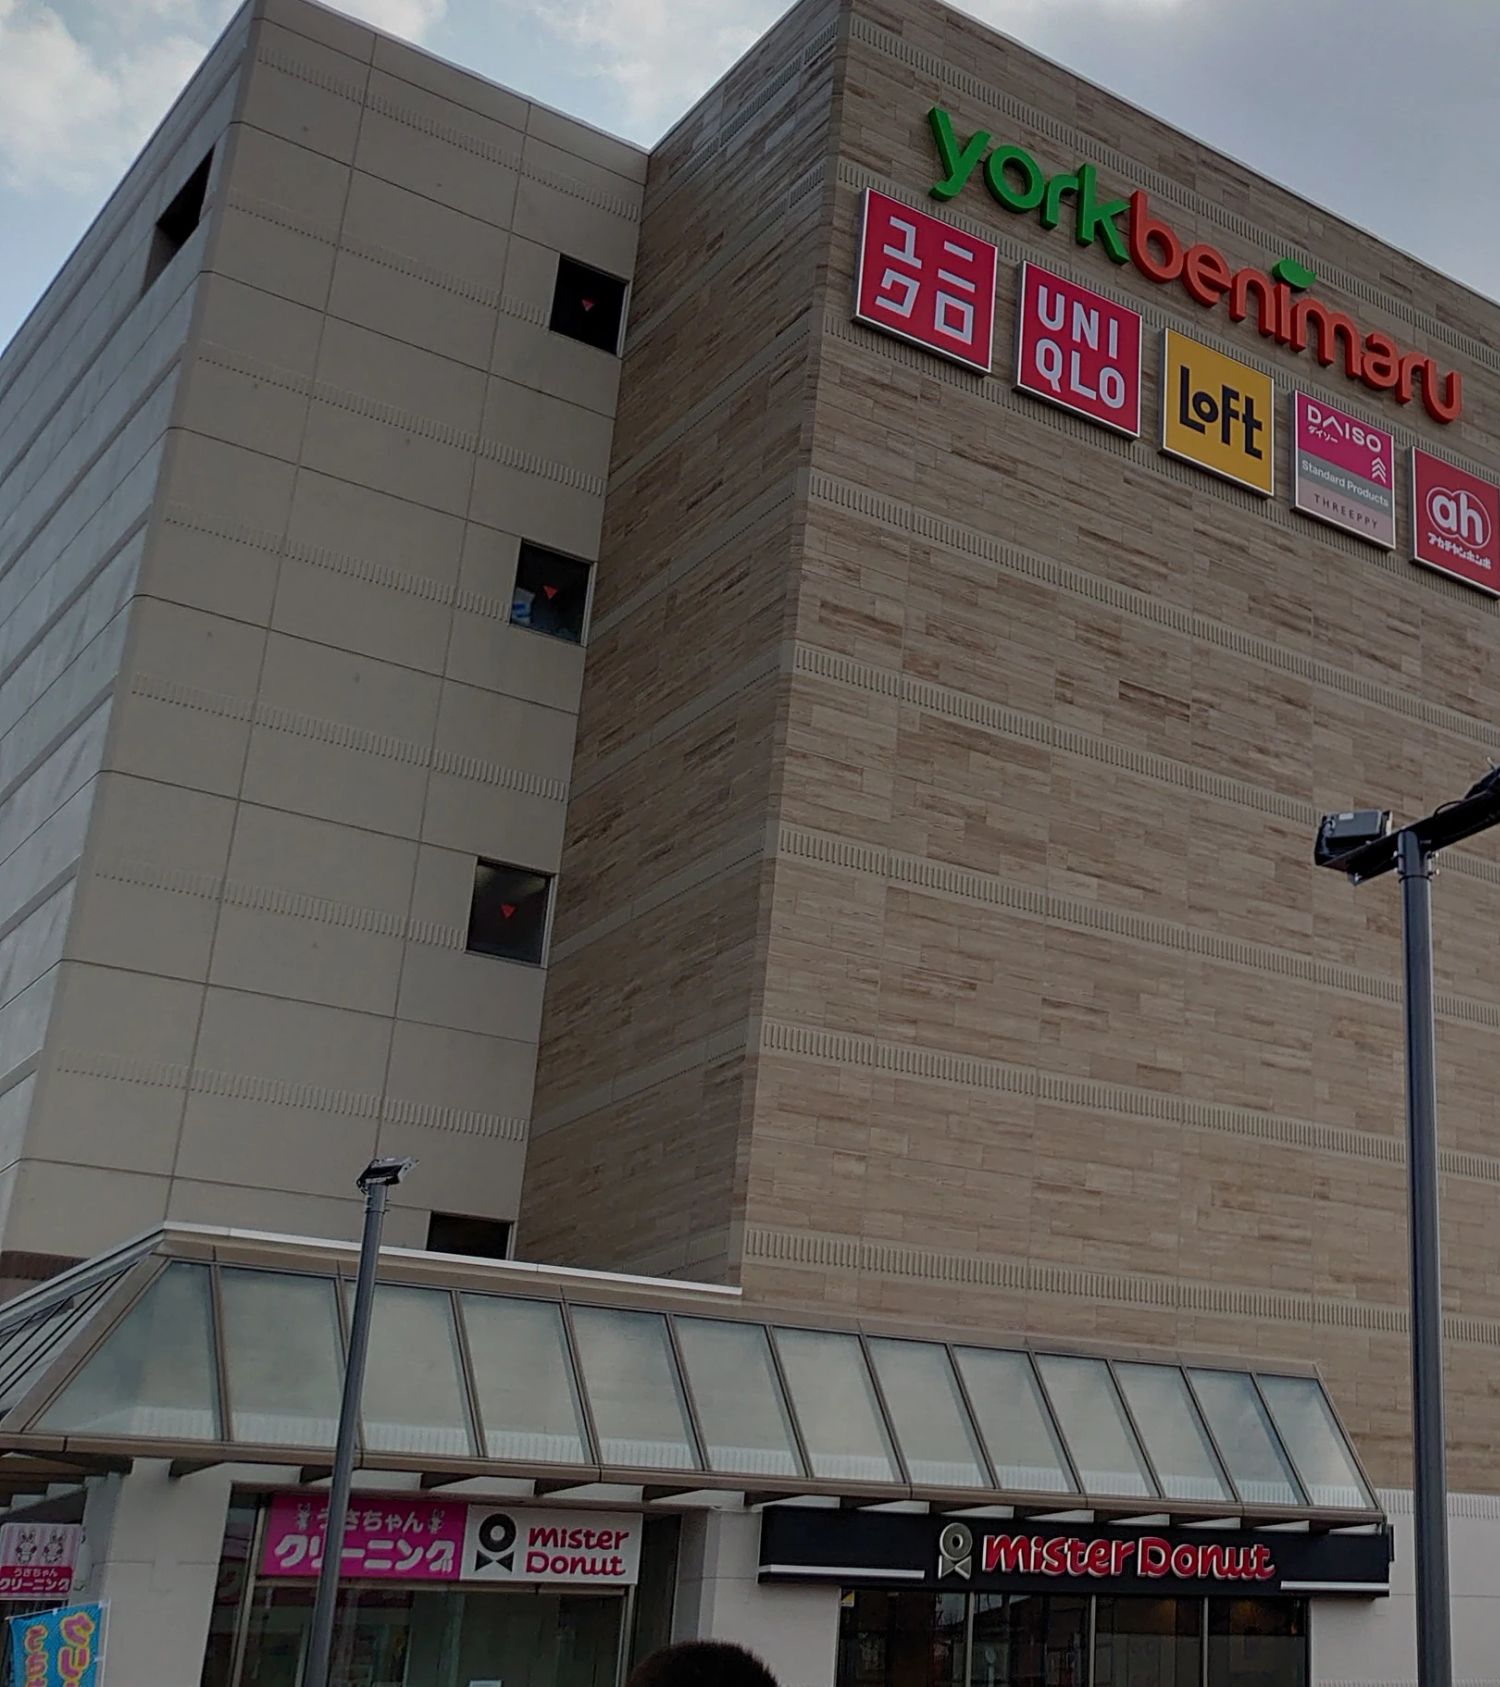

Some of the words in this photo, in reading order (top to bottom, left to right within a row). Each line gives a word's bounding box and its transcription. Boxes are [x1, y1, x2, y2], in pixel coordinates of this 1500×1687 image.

[1038, 285, 1118, 359] UNI
[1035, 338, 1125, 409] QLO
[1307, 404, 1382, 453] DAISO
[1307, 425, 1338, 443] ダイソー
[1302, 459, 1345, 487] Standard
[1347, 480, 1389, 507] Products
[1314, 493, 1378, 529] THREEPPY
[1431, 492, 1483, 544] ah
[525, 1551, 626, 1576] Donut
[1137, 1536, 1276, 1580] Donut
